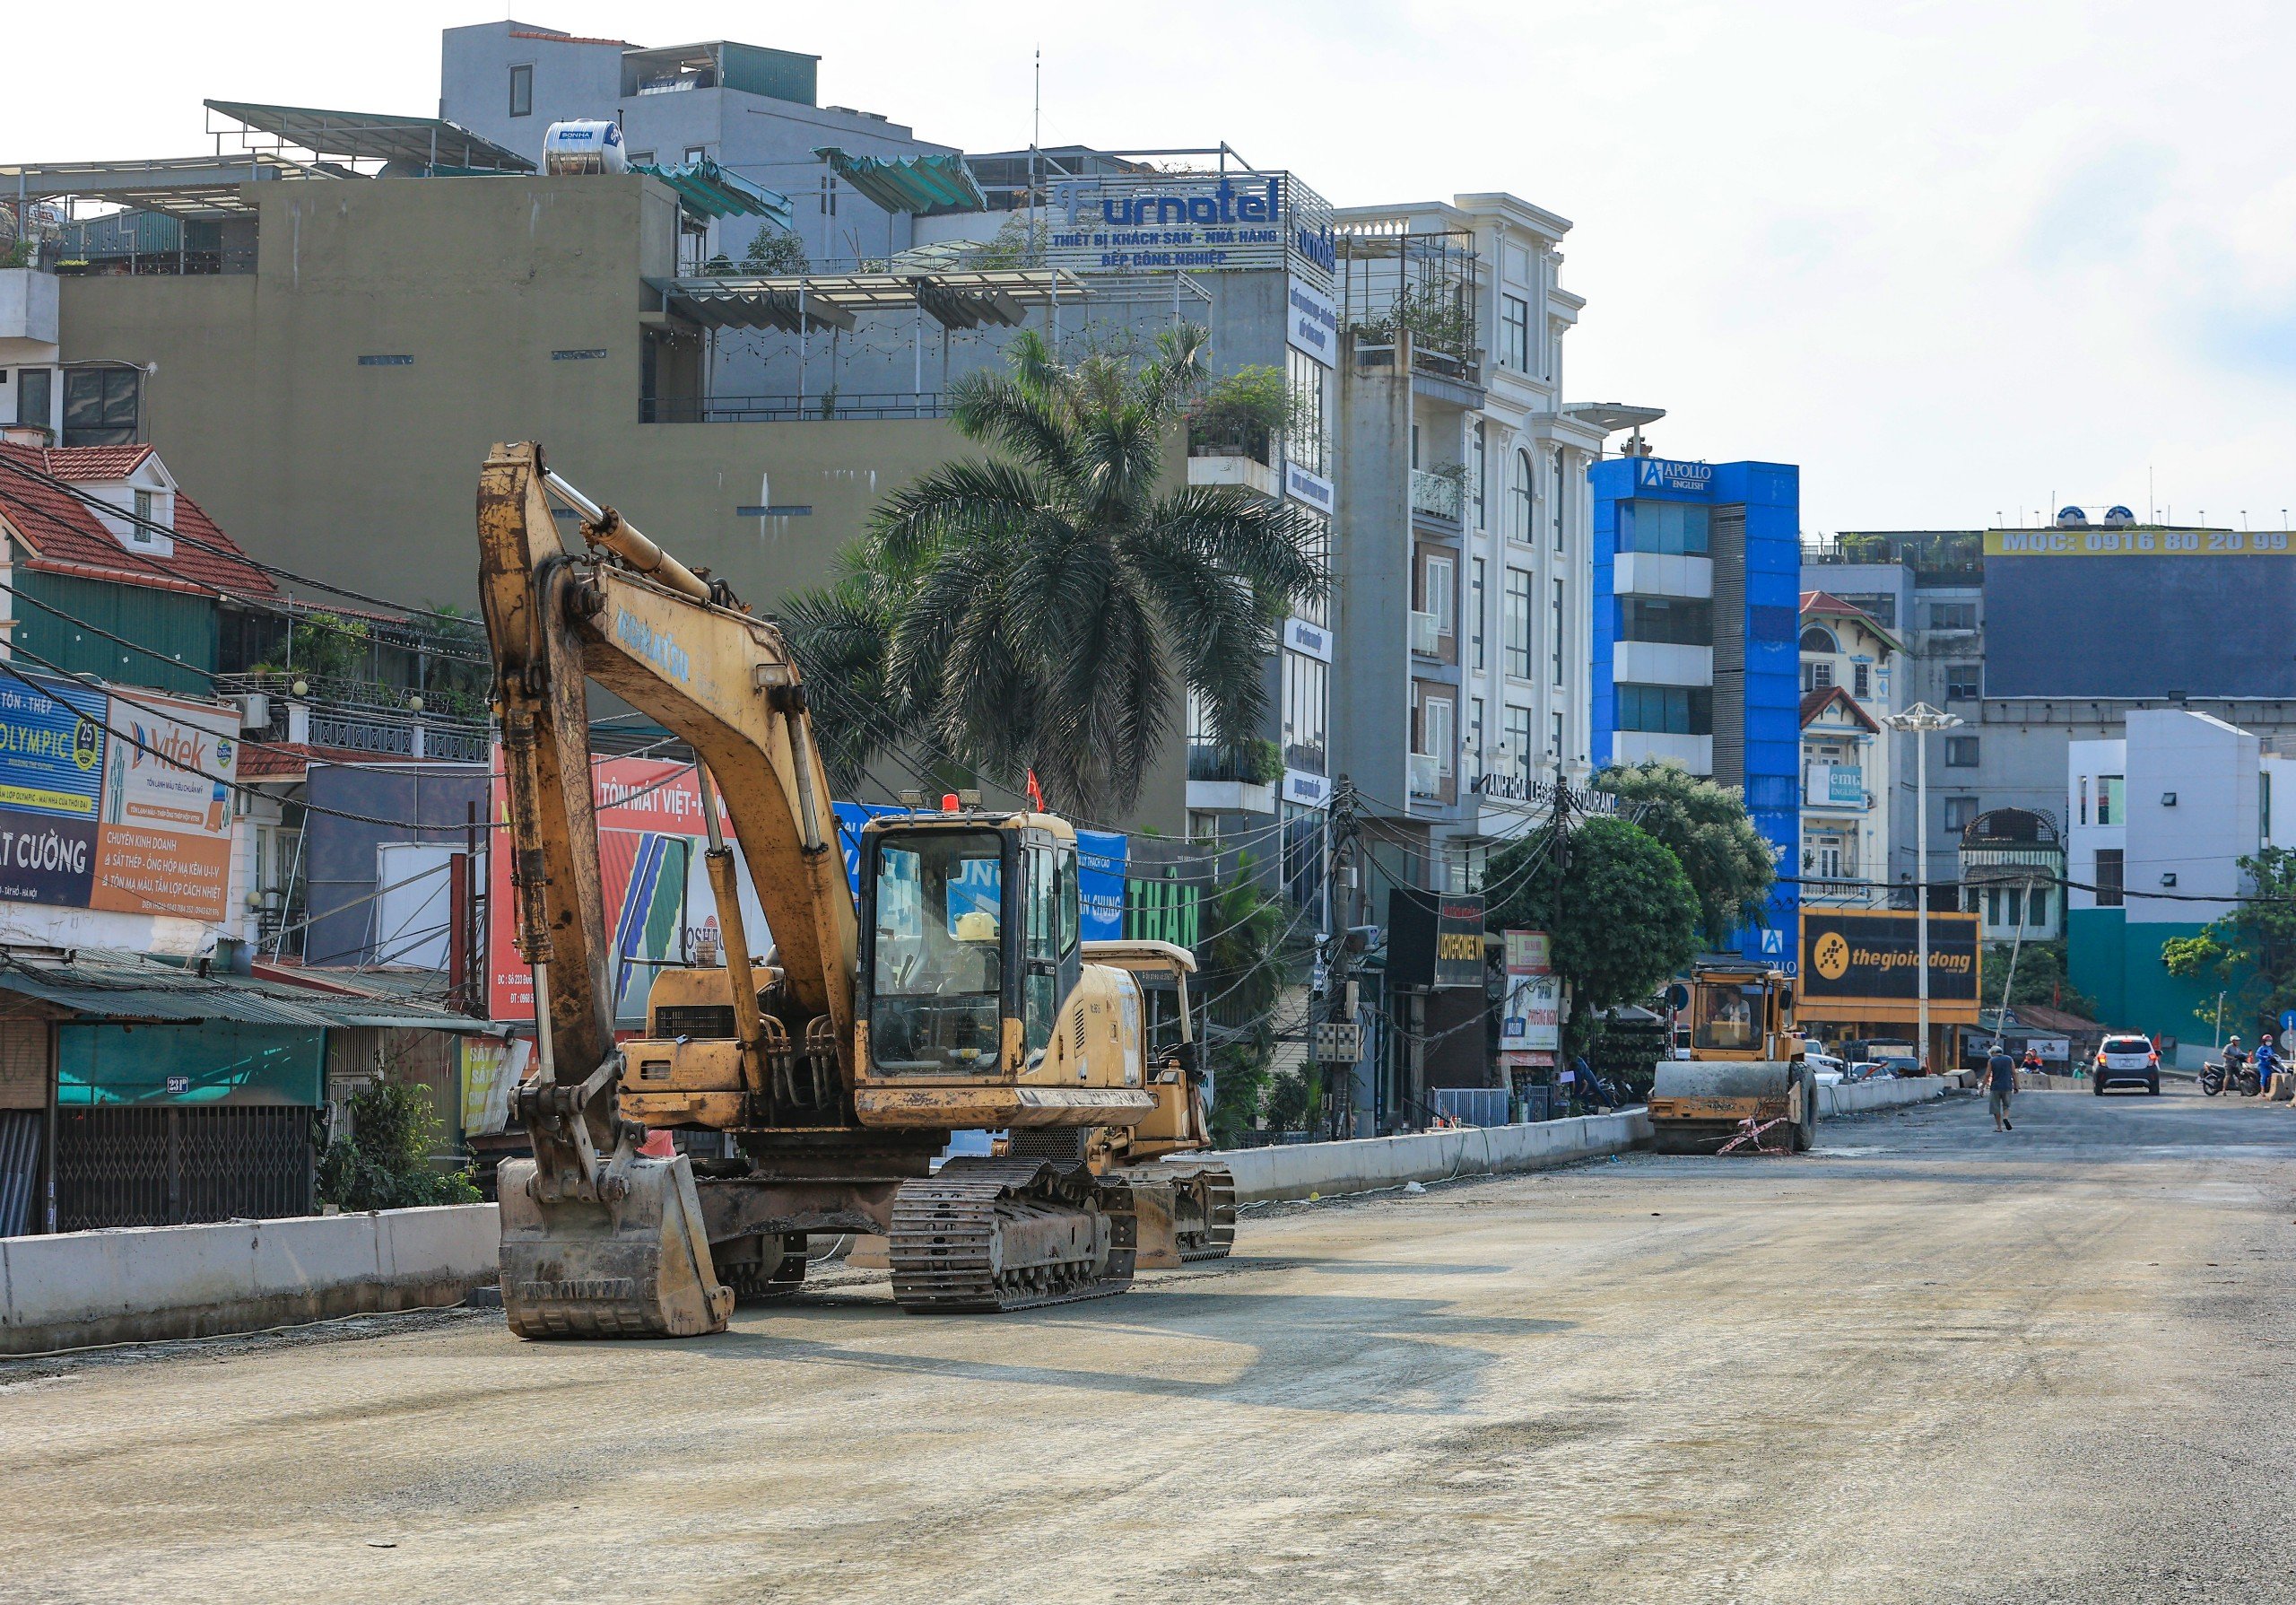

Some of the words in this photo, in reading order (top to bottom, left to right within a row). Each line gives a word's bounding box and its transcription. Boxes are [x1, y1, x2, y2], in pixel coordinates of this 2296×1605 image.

[1094, 234, 1109, 250] BỊ
[1112, 230, 1161, 246] KHÁCH
[1205, 229, 1234, 244] NHÀ
[1238, 228, 1278, 243] HÀNG
[1133, 249, 1170, 266] CÔNG
[1175, 249, 1227, 267] NGHIỆP
[1665, 464, 1711, 479] APOLLO
[1673, 480, 1704, 491] ENGLISH
[2003, 533, 2076, 552] MQC:
[2085, 533, 2155, 551] 0916
[2164, 533, 2199, 551] 80
[2208, 533, 2244, 551] 20
[2252, 533, 2288, 551] 99
[1, 690, 21, 710] TÔN
[29, 695, 53, 714] THÉP
[0, 722, 68, 758] OLYMPIC
[81, 723, 92, 742] 25
[16, 792, 36, 802] OLYMPIC
[601, 777, 629, 809] TÔN
[631, 781, 660, 812] MÁT
[1531, 780, 1556, 806] LEGEN
[1831, 788, 1860, 796] ENGLISH
[16, 828, 87, 874] CƯỜNG
[107, 831, 135, 845] CHUYÊN
[135, 836, 152, 848] KINH
[152, 837, 177, 851] DOANH
[112, 850, 125, 866] SẮT
[126, 853, 142, 868] THÉP
[146, 852, 161, 871] ỐNG
[162, 859, 177, 876] HỘP
[178, 861, 188, 877] MẠ
[204, 866, 220, 877] U-I-V
[110, 873, 125, 888] TÔN
[126, 878, 135, 893] MẠ
[155, 876, 169, 893] TẤM
[169, 881, 183, 897] LỢP
[182, 881, 201, 897] CÁCH
[202, 884, 222, 902] NHIỆT
[1092, 894, 1121, 917] CHUNG
[1853, 948, 1970, 973] thegioiddong
